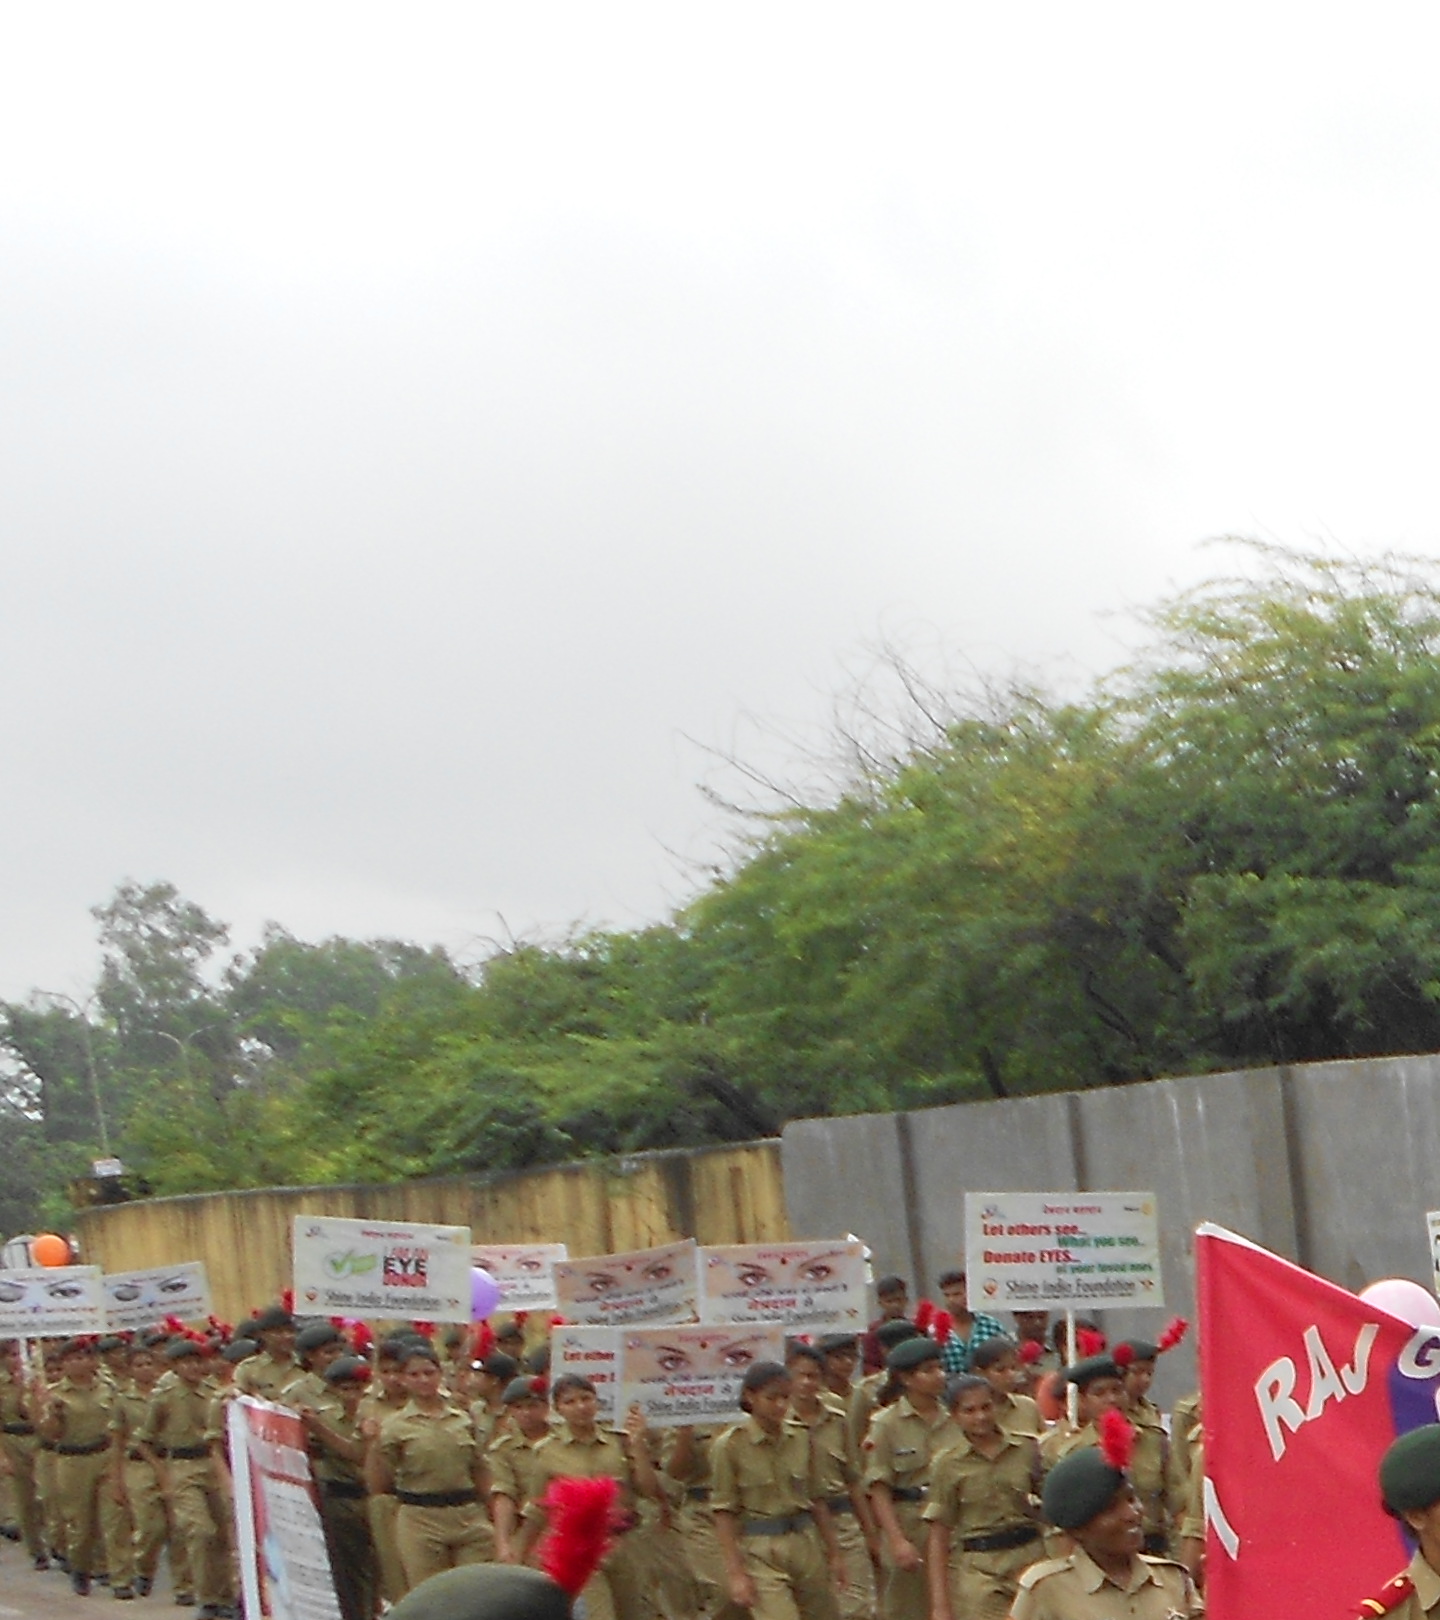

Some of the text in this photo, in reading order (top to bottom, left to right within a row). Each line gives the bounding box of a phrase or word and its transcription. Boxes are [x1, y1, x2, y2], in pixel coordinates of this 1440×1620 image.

[983, 1223, 1004, 1236] Let
[983, 1250, 1036, 1263] Donate
[383, 1256, 427, 1275] EYE
[1254, 1323, 1379, 1462] RAJ
